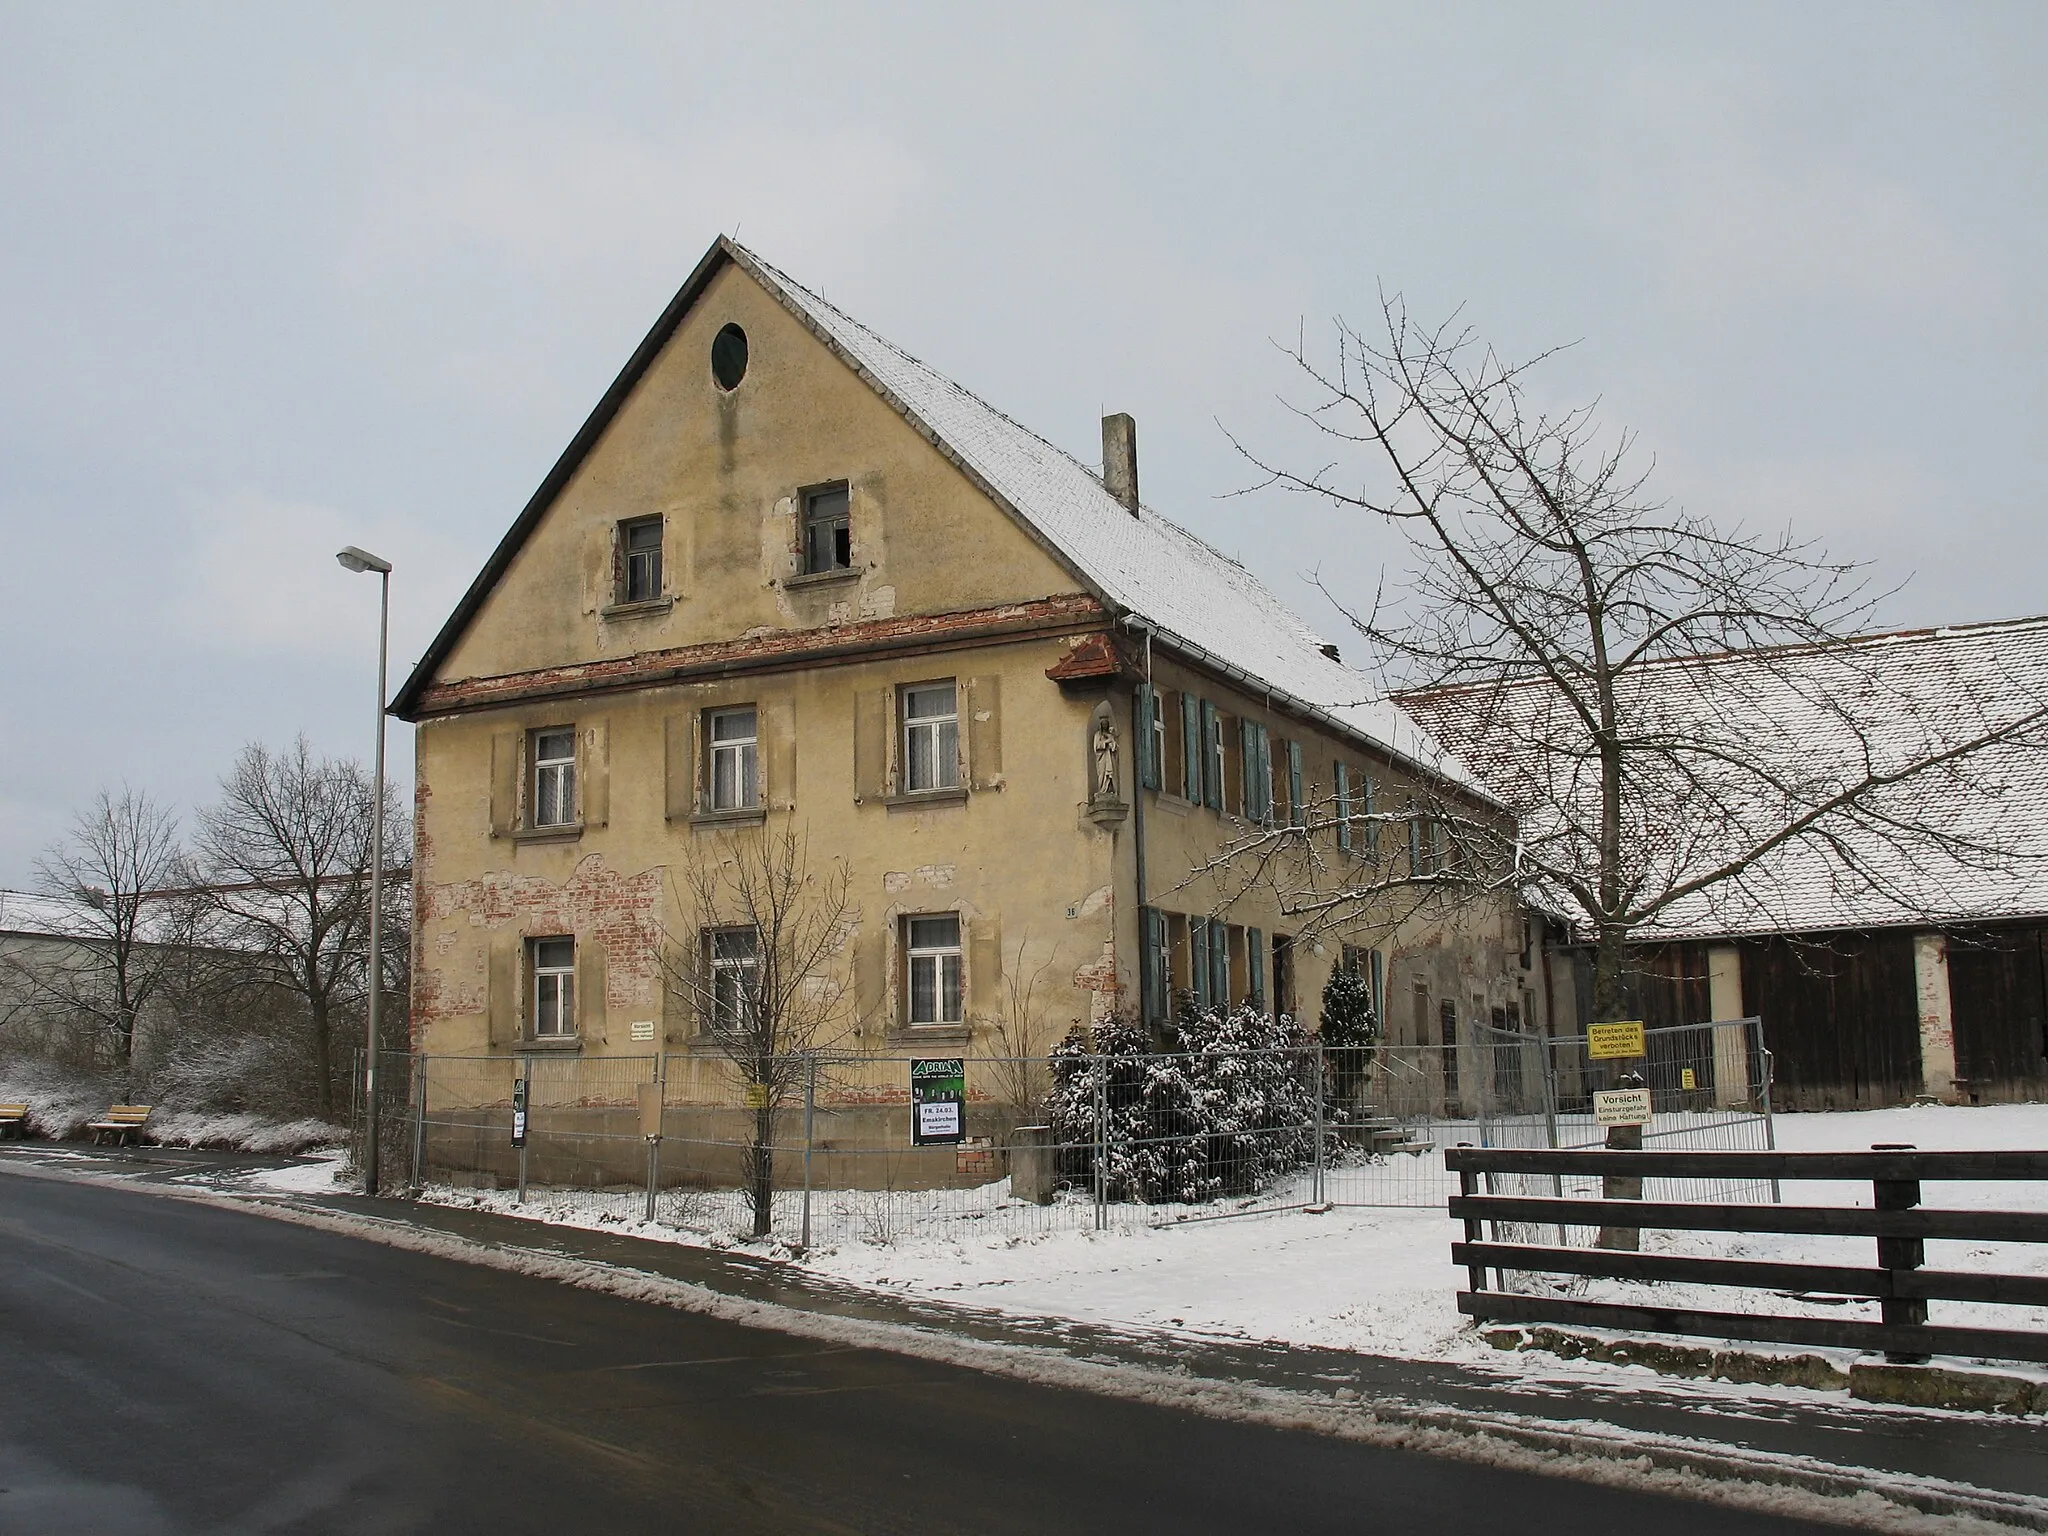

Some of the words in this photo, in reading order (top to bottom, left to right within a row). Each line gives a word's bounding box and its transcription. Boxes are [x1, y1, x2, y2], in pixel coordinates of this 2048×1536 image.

[1592, 1027, 1623, 1035] Betreten
[1593, 1034, 1638, 1042] Grundstücks
[1600, 1041, 1634, 1049] verboten!
[913, 1060, 963, 1075] ADRIAN
[1602, 1094, 1642, 1104] Vorsicht
[1598, 1105, 1647, 1114] Einsturzgefahr
[1619, 1112, 1649, 1120] Haftung!
